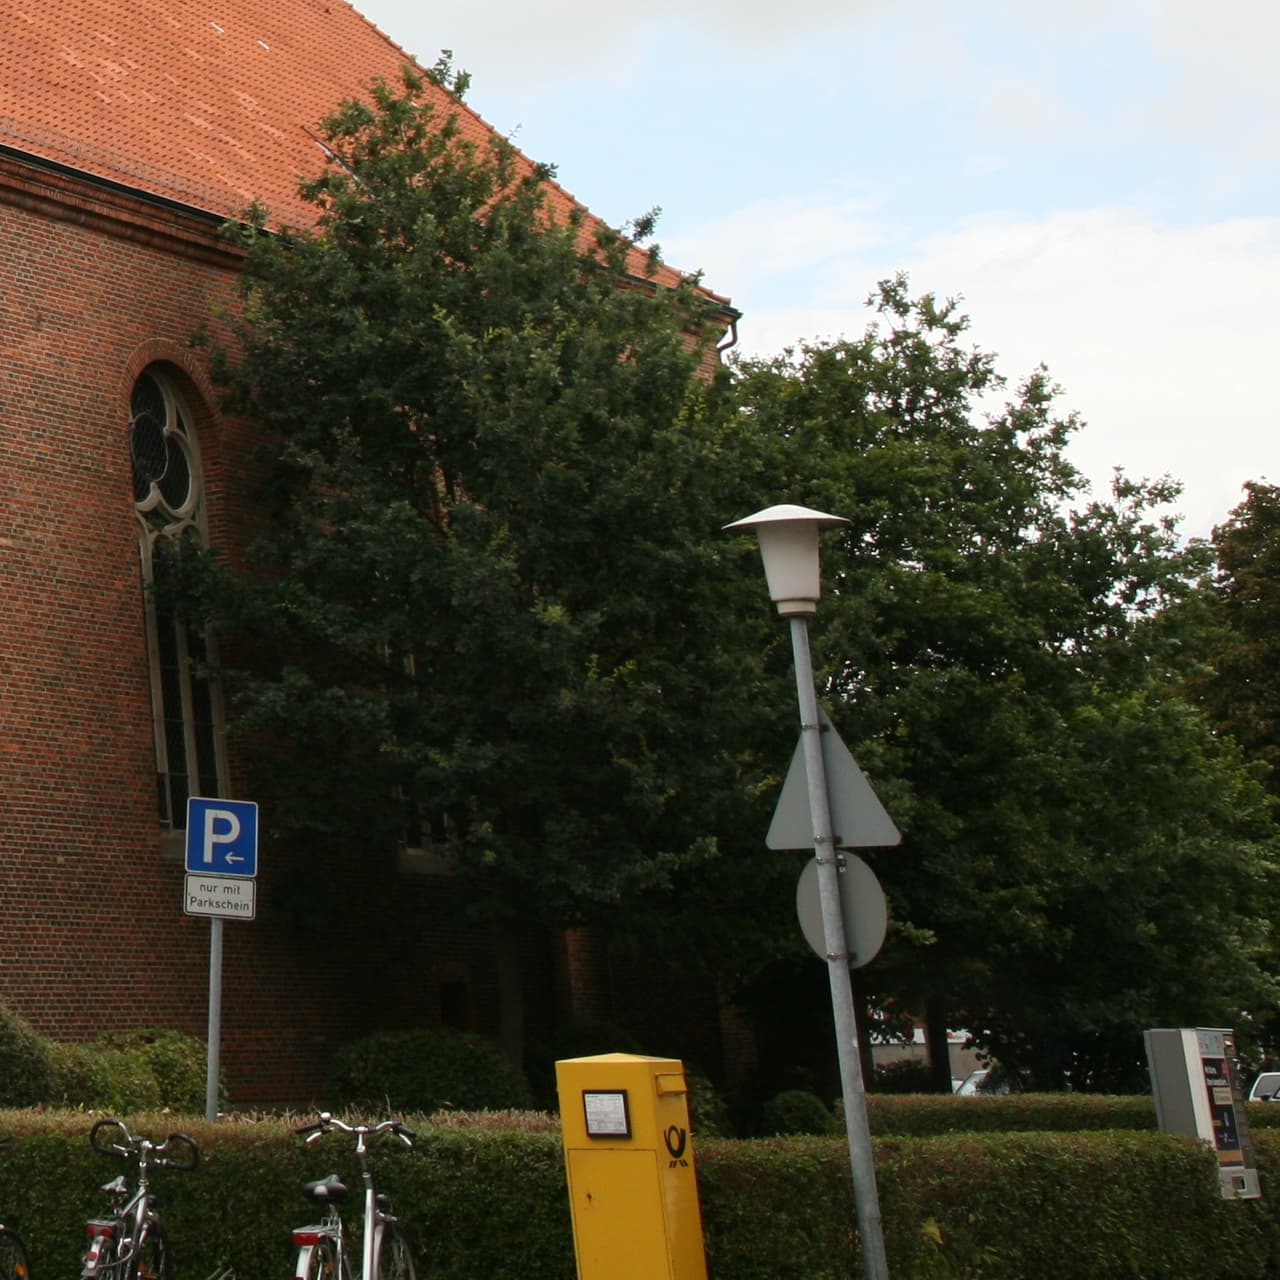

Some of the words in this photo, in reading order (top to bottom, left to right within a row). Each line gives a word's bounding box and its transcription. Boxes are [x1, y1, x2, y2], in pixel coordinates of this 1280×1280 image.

[203, 809, 240, 863] P
[200, 883, 218, 893] nur
[223, 884, 241, 895] mit
[190, 895, 250, 911] Parkschein
